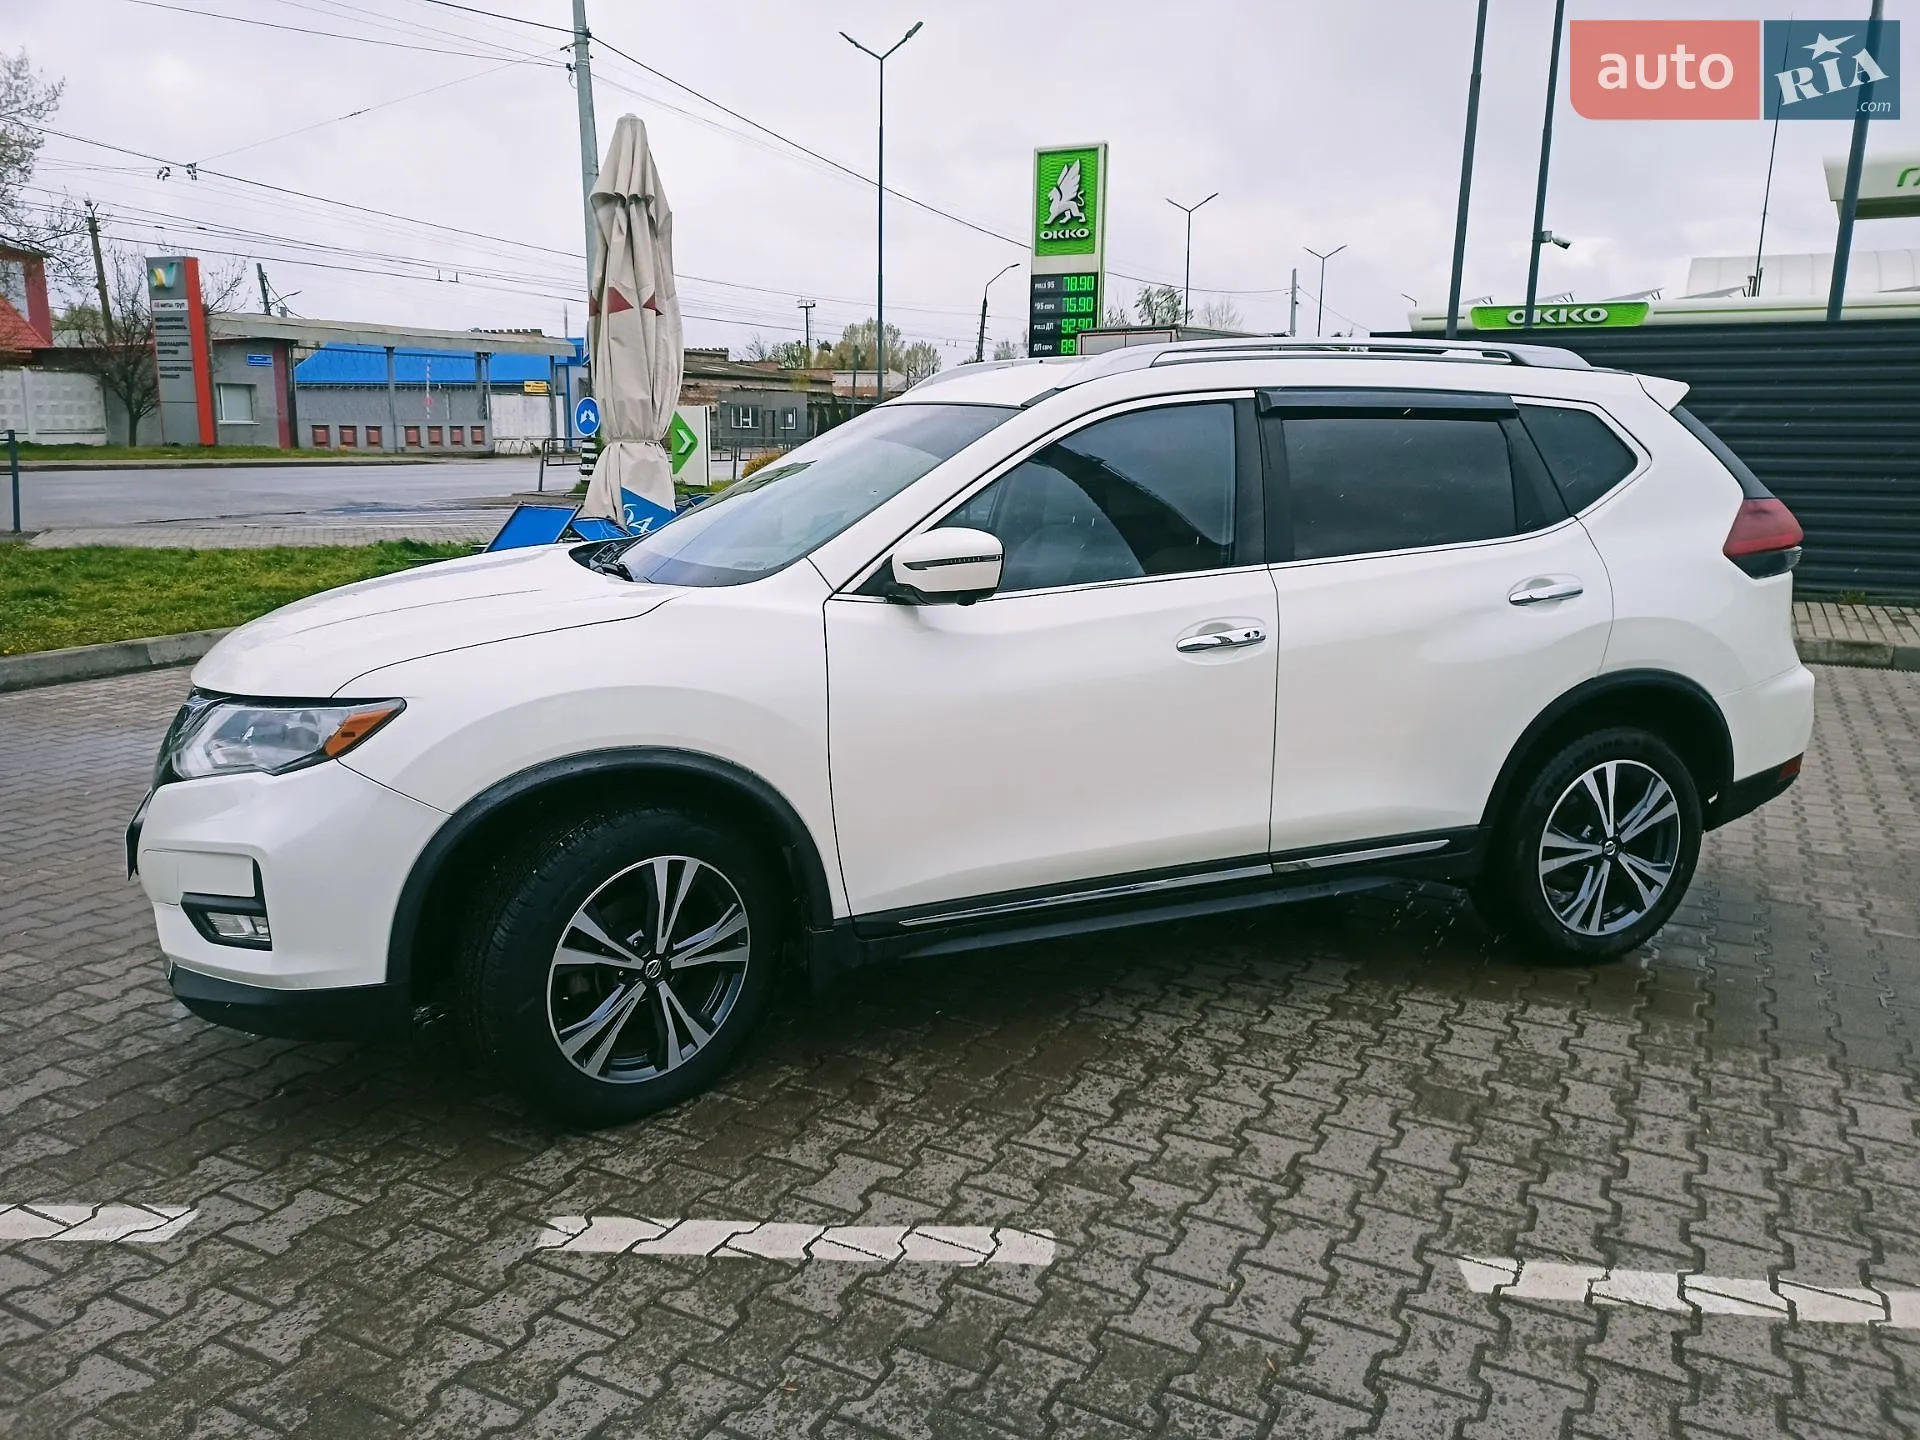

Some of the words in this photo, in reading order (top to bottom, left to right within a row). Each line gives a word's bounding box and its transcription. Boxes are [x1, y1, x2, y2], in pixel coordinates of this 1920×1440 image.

[1040, 228, 1090, 240] OKKO
[1063, 276, 1094, 291] 78.90
[1062, 297, 1093, 312] 75.90
[1507, 308, 1609, 324] OKKO
